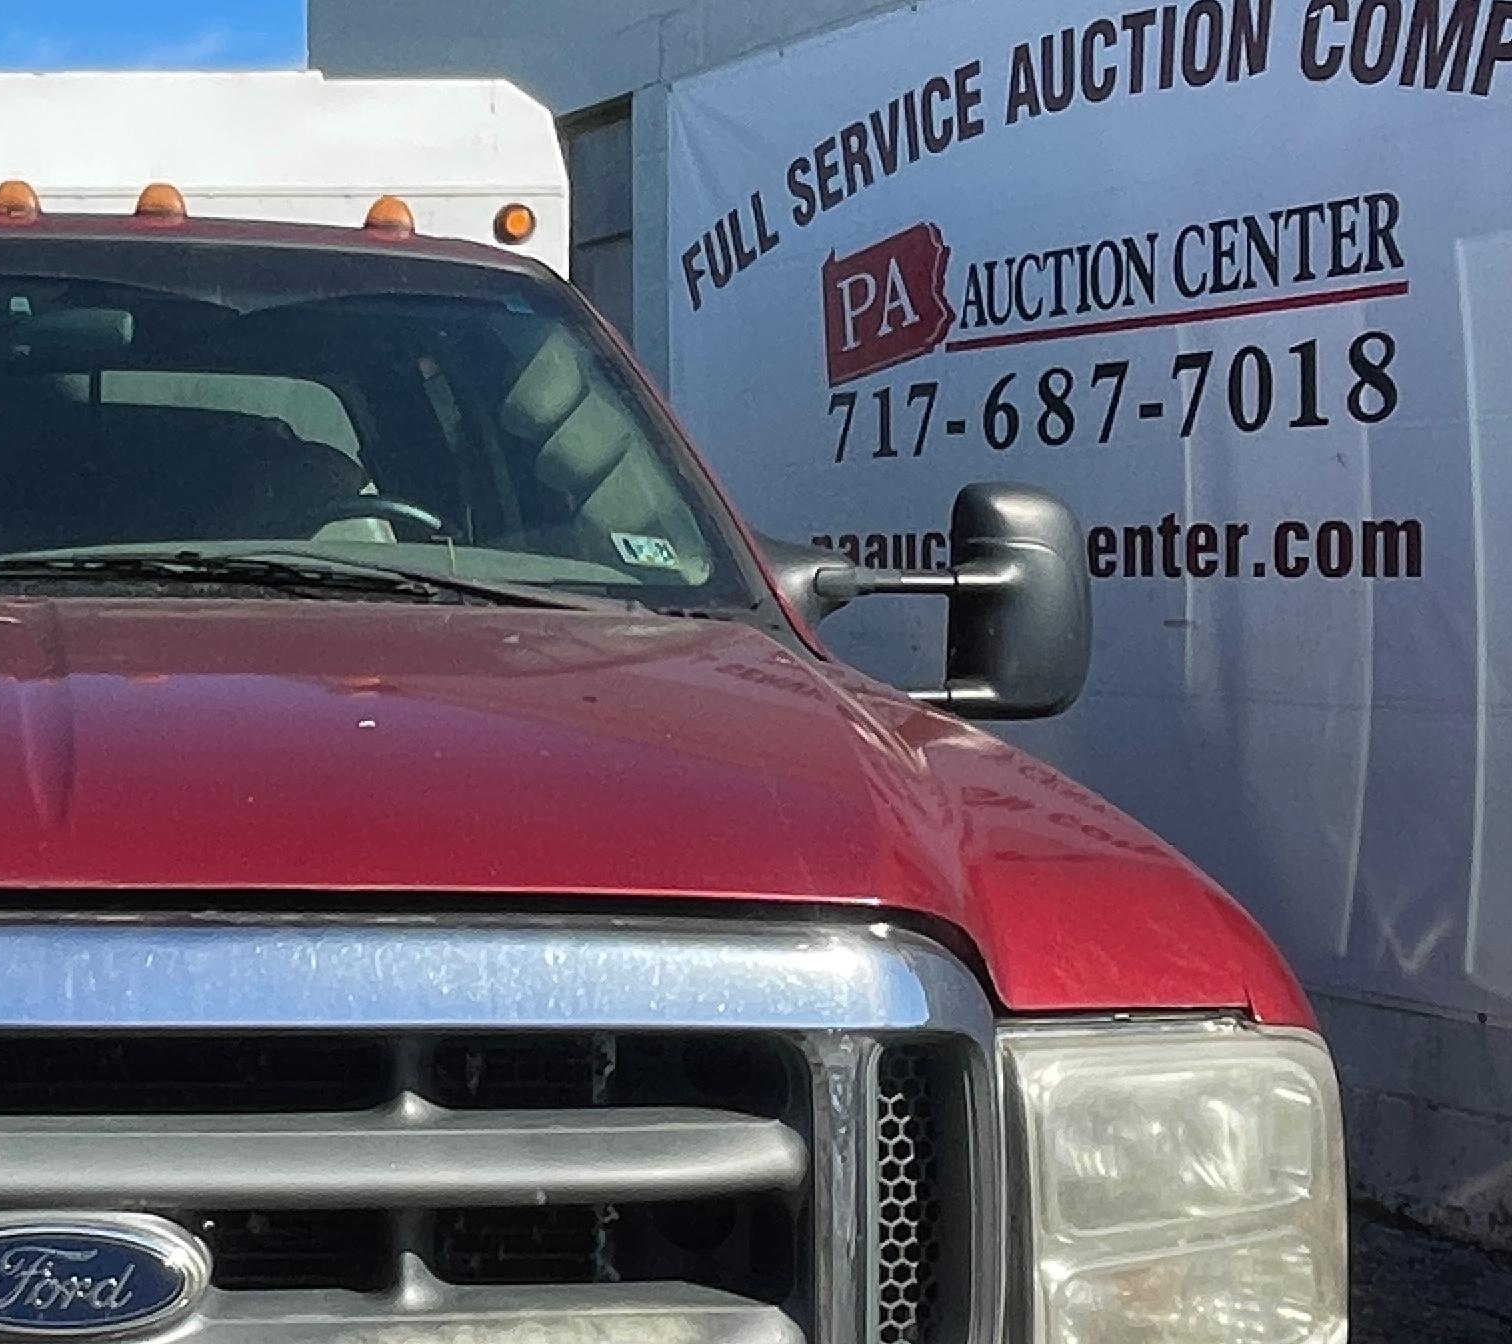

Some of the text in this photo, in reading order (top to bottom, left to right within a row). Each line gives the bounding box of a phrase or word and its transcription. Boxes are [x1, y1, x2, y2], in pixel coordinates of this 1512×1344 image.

[681, 190, 780, 311] FULL
[787, 59, 984, 227] SERVICE
[837, 192, 1405, 352] PA AUCTION CENTER
[827, 330, 1398, 464] 717-687-7018
